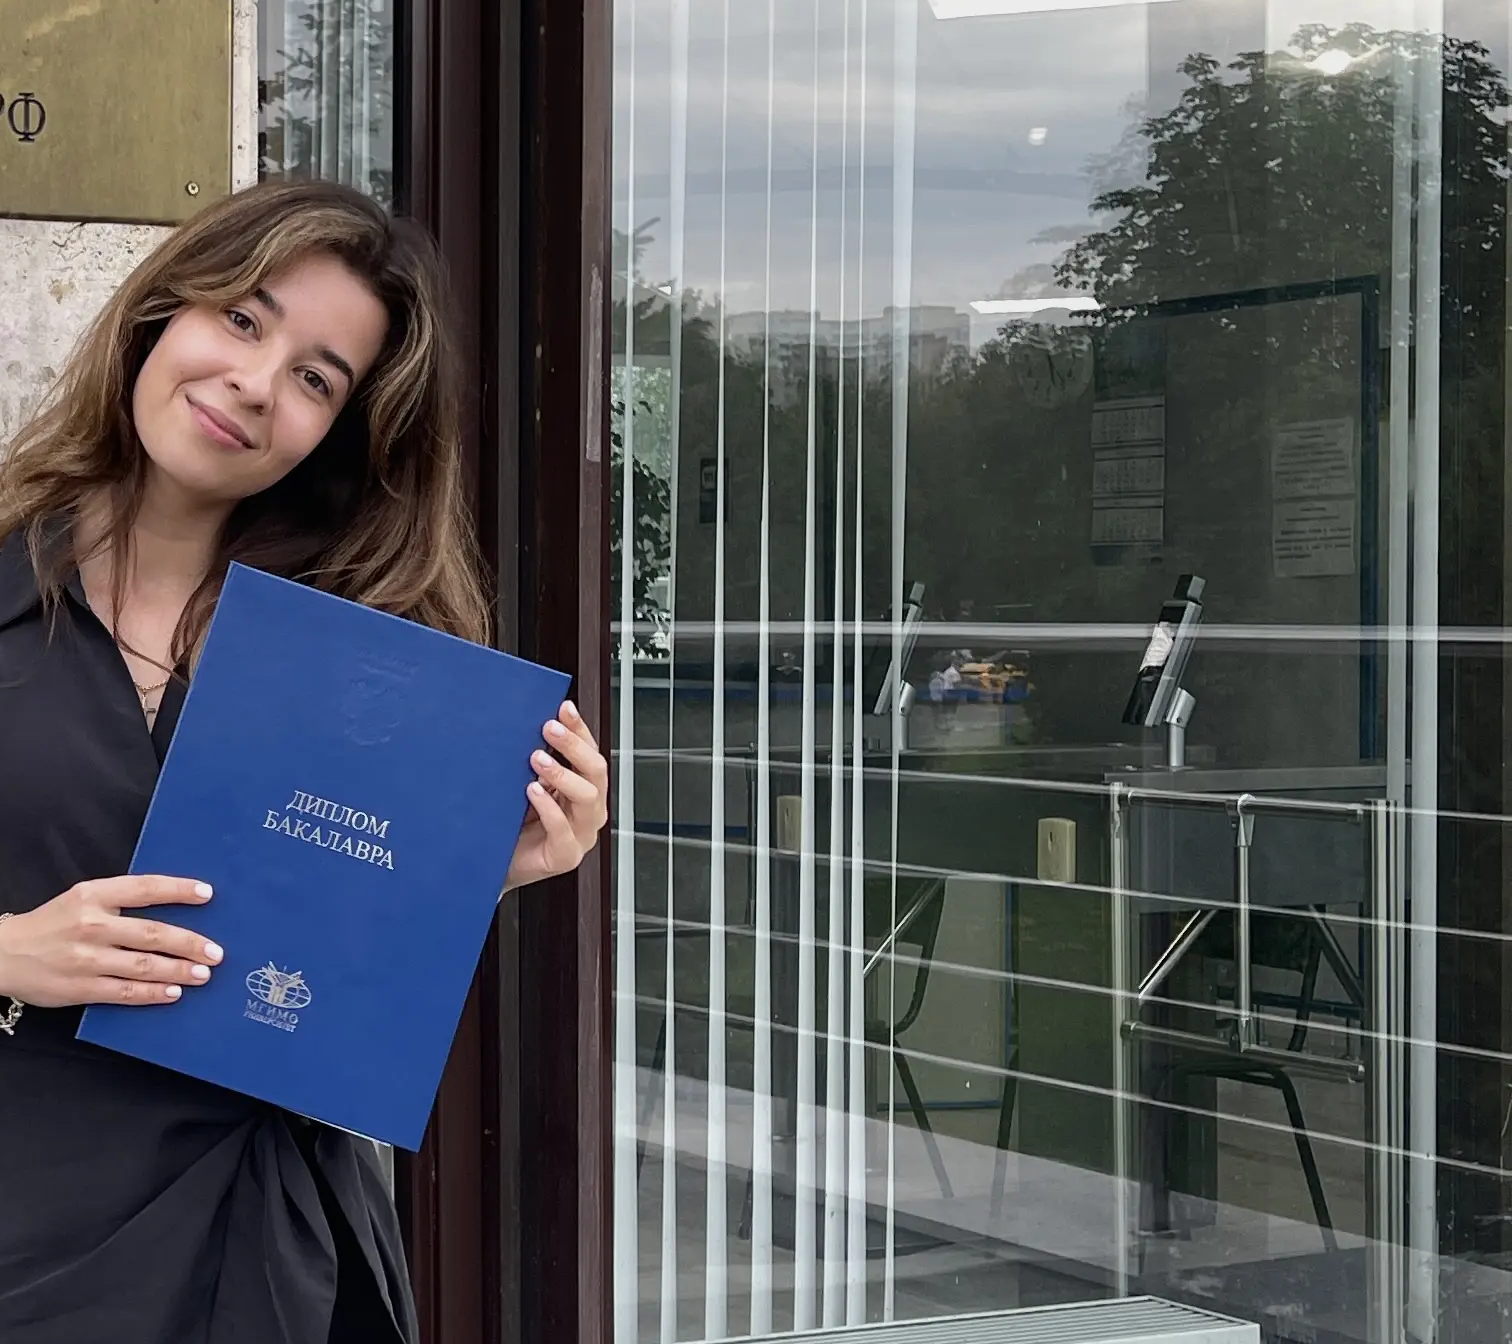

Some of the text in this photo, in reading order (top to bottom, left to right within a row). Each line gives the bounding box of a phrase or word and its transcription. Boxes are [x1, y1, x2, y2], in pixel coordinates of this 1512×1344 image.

[286, 789, 391, 839] ДИПЛОМ
[262, 809, 395, 871] БАКАЛАВРА
[246, 998, 299, 1025] МГИМО
